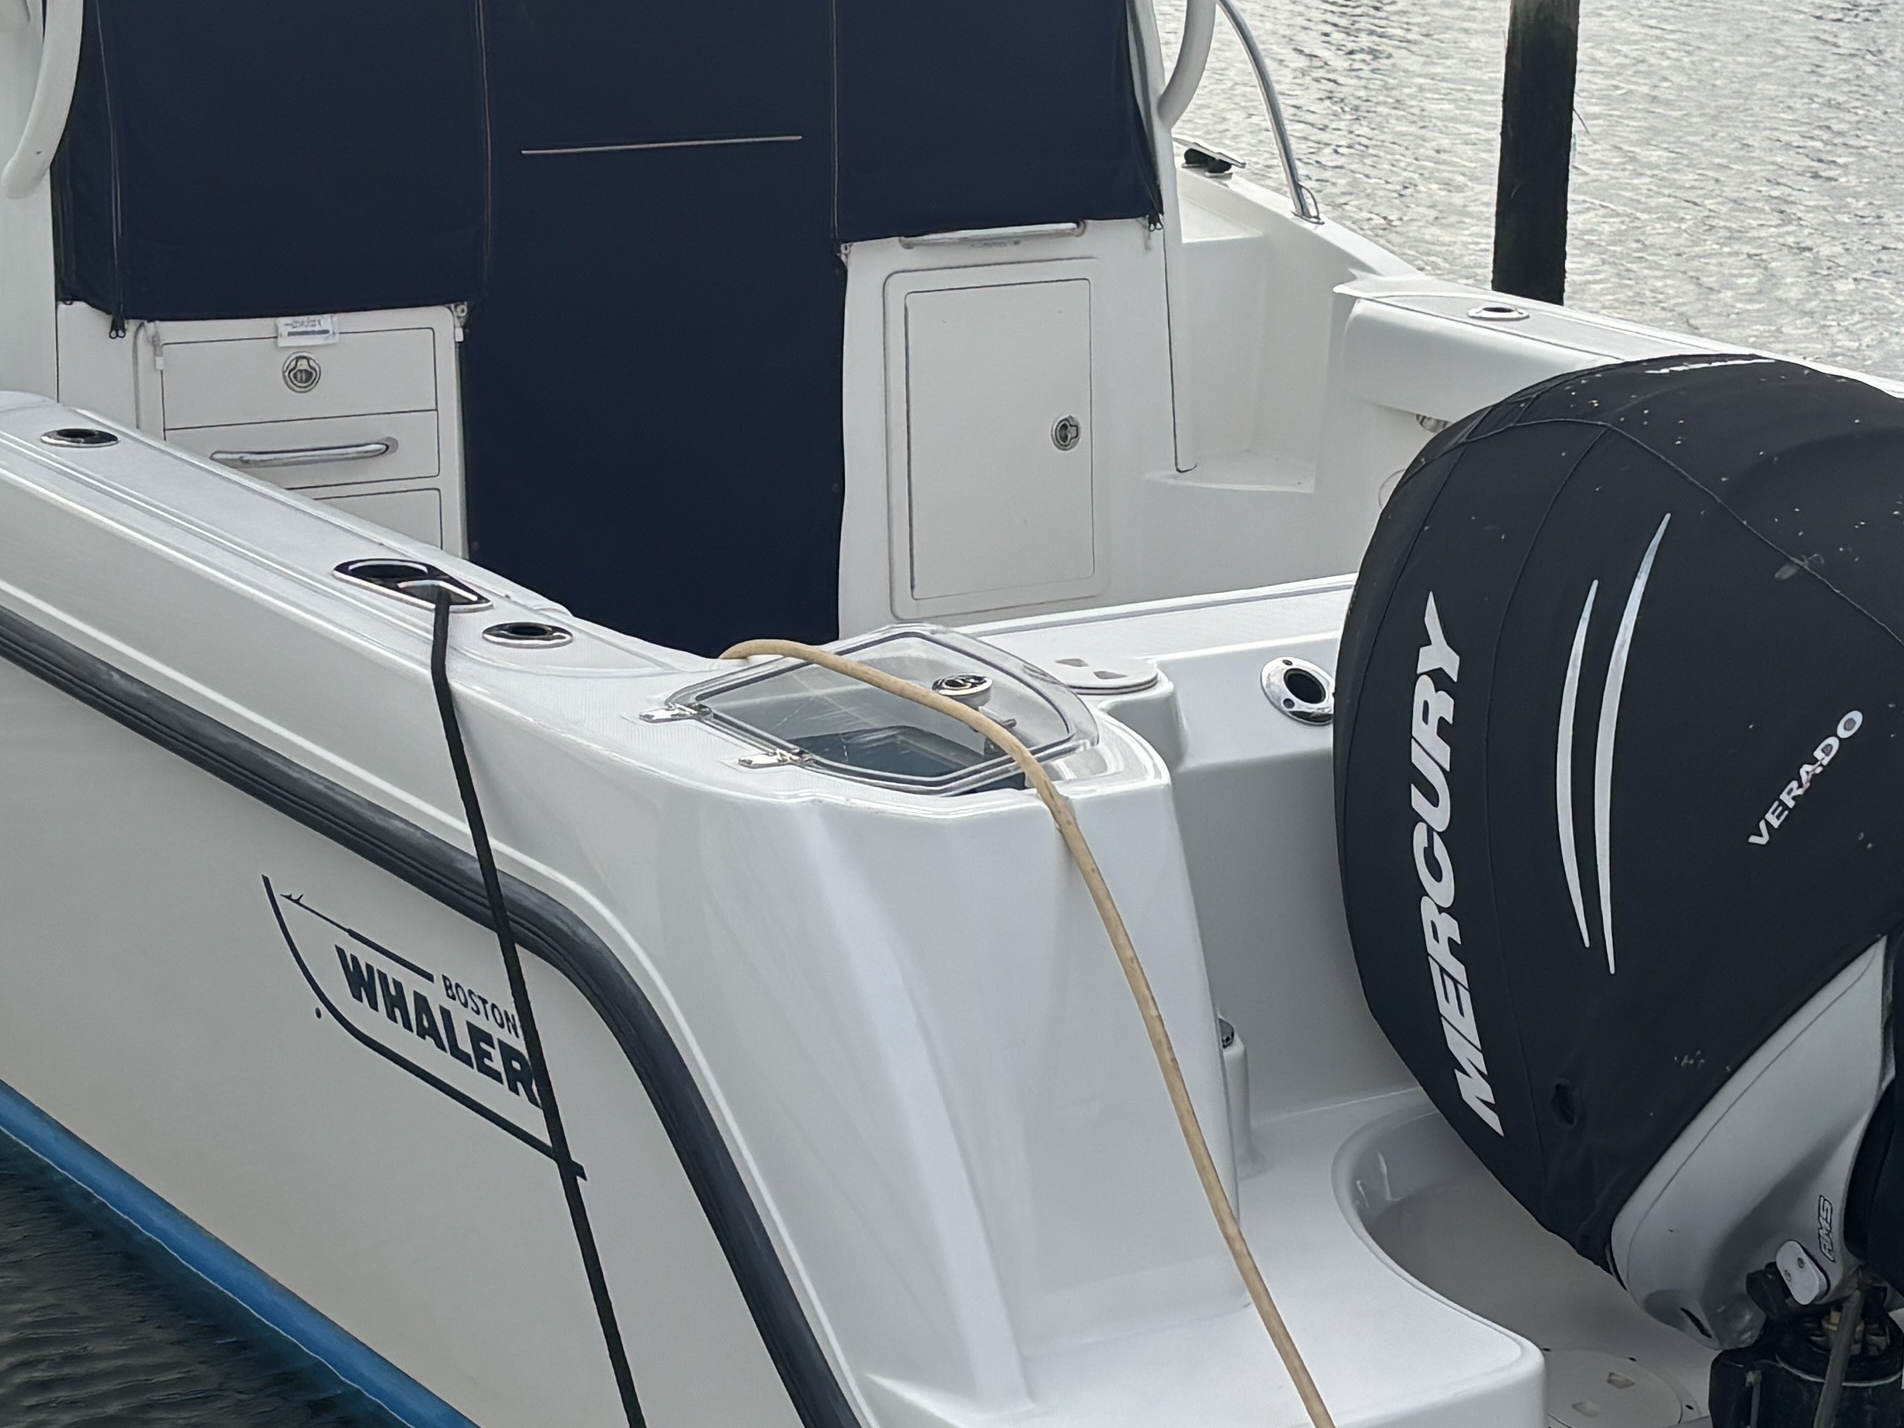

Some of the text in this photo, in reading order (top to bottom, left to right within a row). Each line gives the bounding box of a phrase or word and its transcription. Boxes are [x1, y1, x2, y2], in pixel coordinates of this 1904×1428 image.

[1748, 710, 1864, 848] VERADO
[1410, 591, 1504, 1137] MERCURY
[334, 944, 544, 1111] WHALER
[441, 973, 521, 1039] BOSTON
